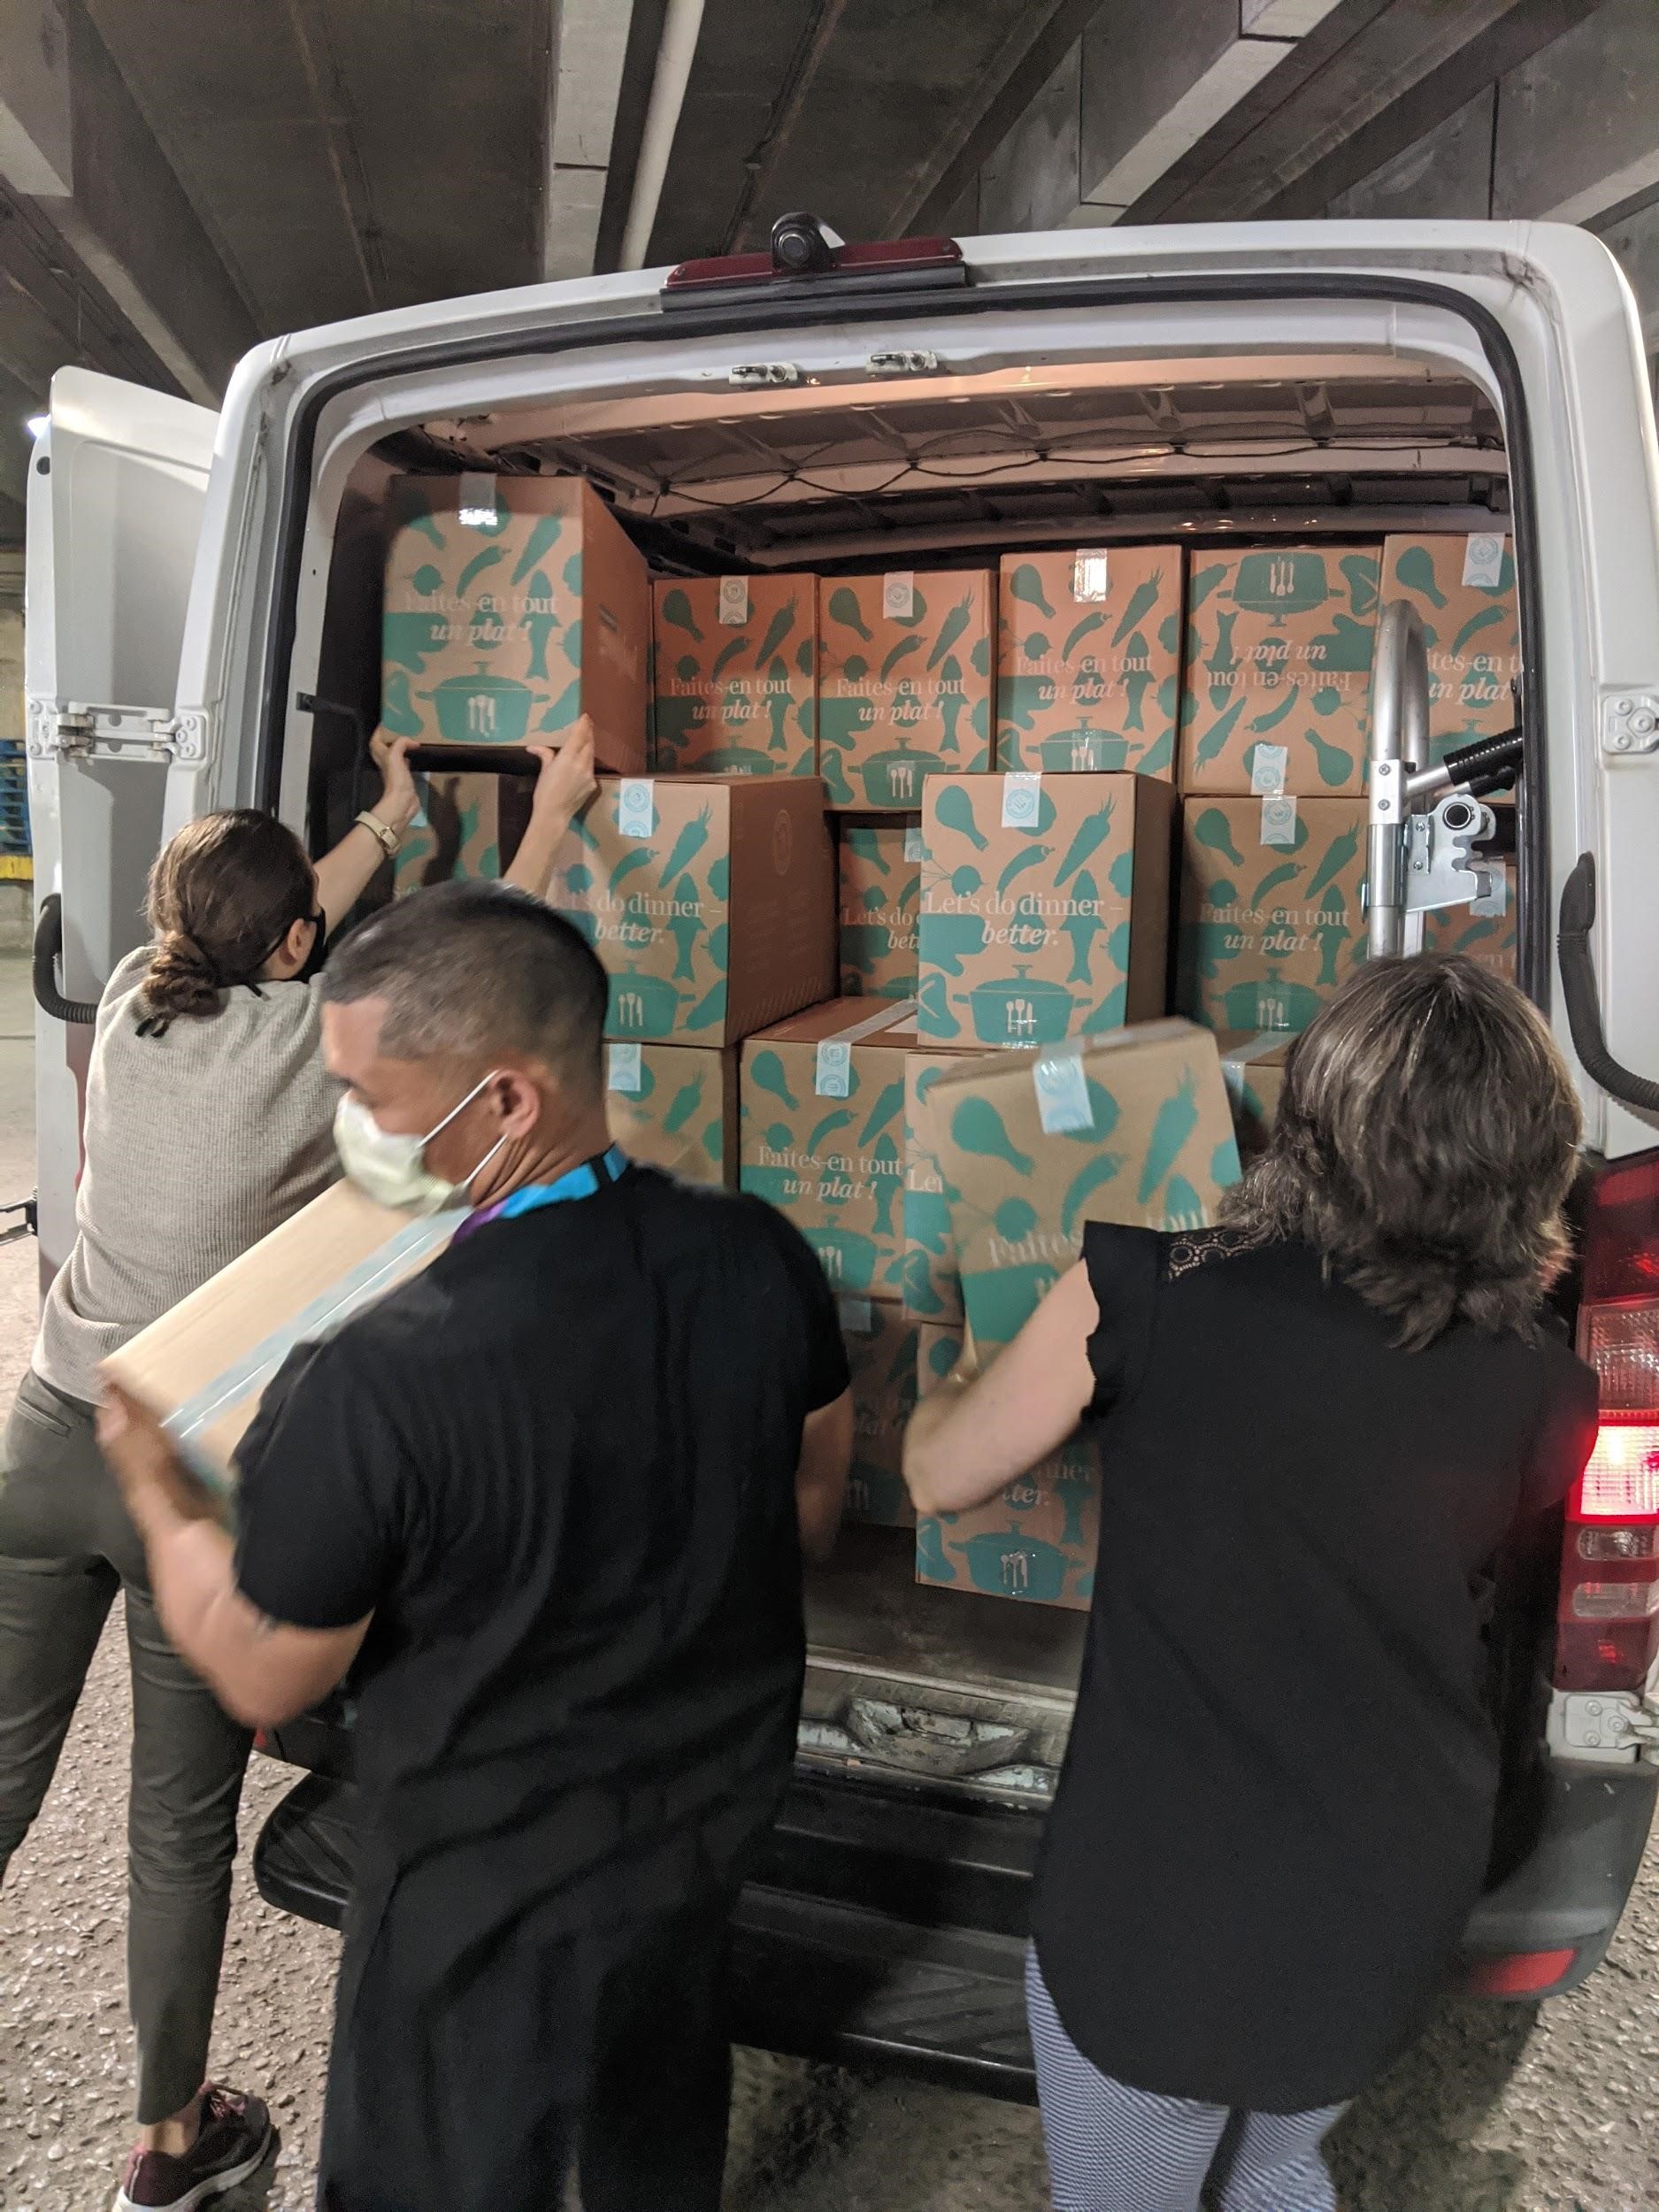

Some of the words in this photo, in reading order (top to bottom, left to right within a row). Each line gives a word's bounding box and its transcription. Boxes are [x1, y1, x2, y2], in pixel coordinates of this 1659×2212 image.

[430, 624, 464, 641] un
[1295, 644, 1326, 660] un
[1112, 655, 1154, 672] tout
[756, 677, 793, 695] tout
[928, 678, 966, 695] tout
[1207, 671, 1247, 688] tout
[1037, 685, 1066, 701] un
[692, 706, 716, 719] un
[858, 706, 885, 721] un
[596, 889, 625, 912] do
[628, 891, 704, 918] dinner
[985, 891, 1017, 915] do
[1018, 892, 1105, 917] dinner
[889, 906, 913, 926] do
[1305, 907, 1352, 927] tout
[594, 918, 664, 943] better.
[980, 920, 1059, 946] better.
[1224, 933, 1254, 949] un
[859, 1156, 904, 1176] tout
[782, 1179, 812, 1194] un
